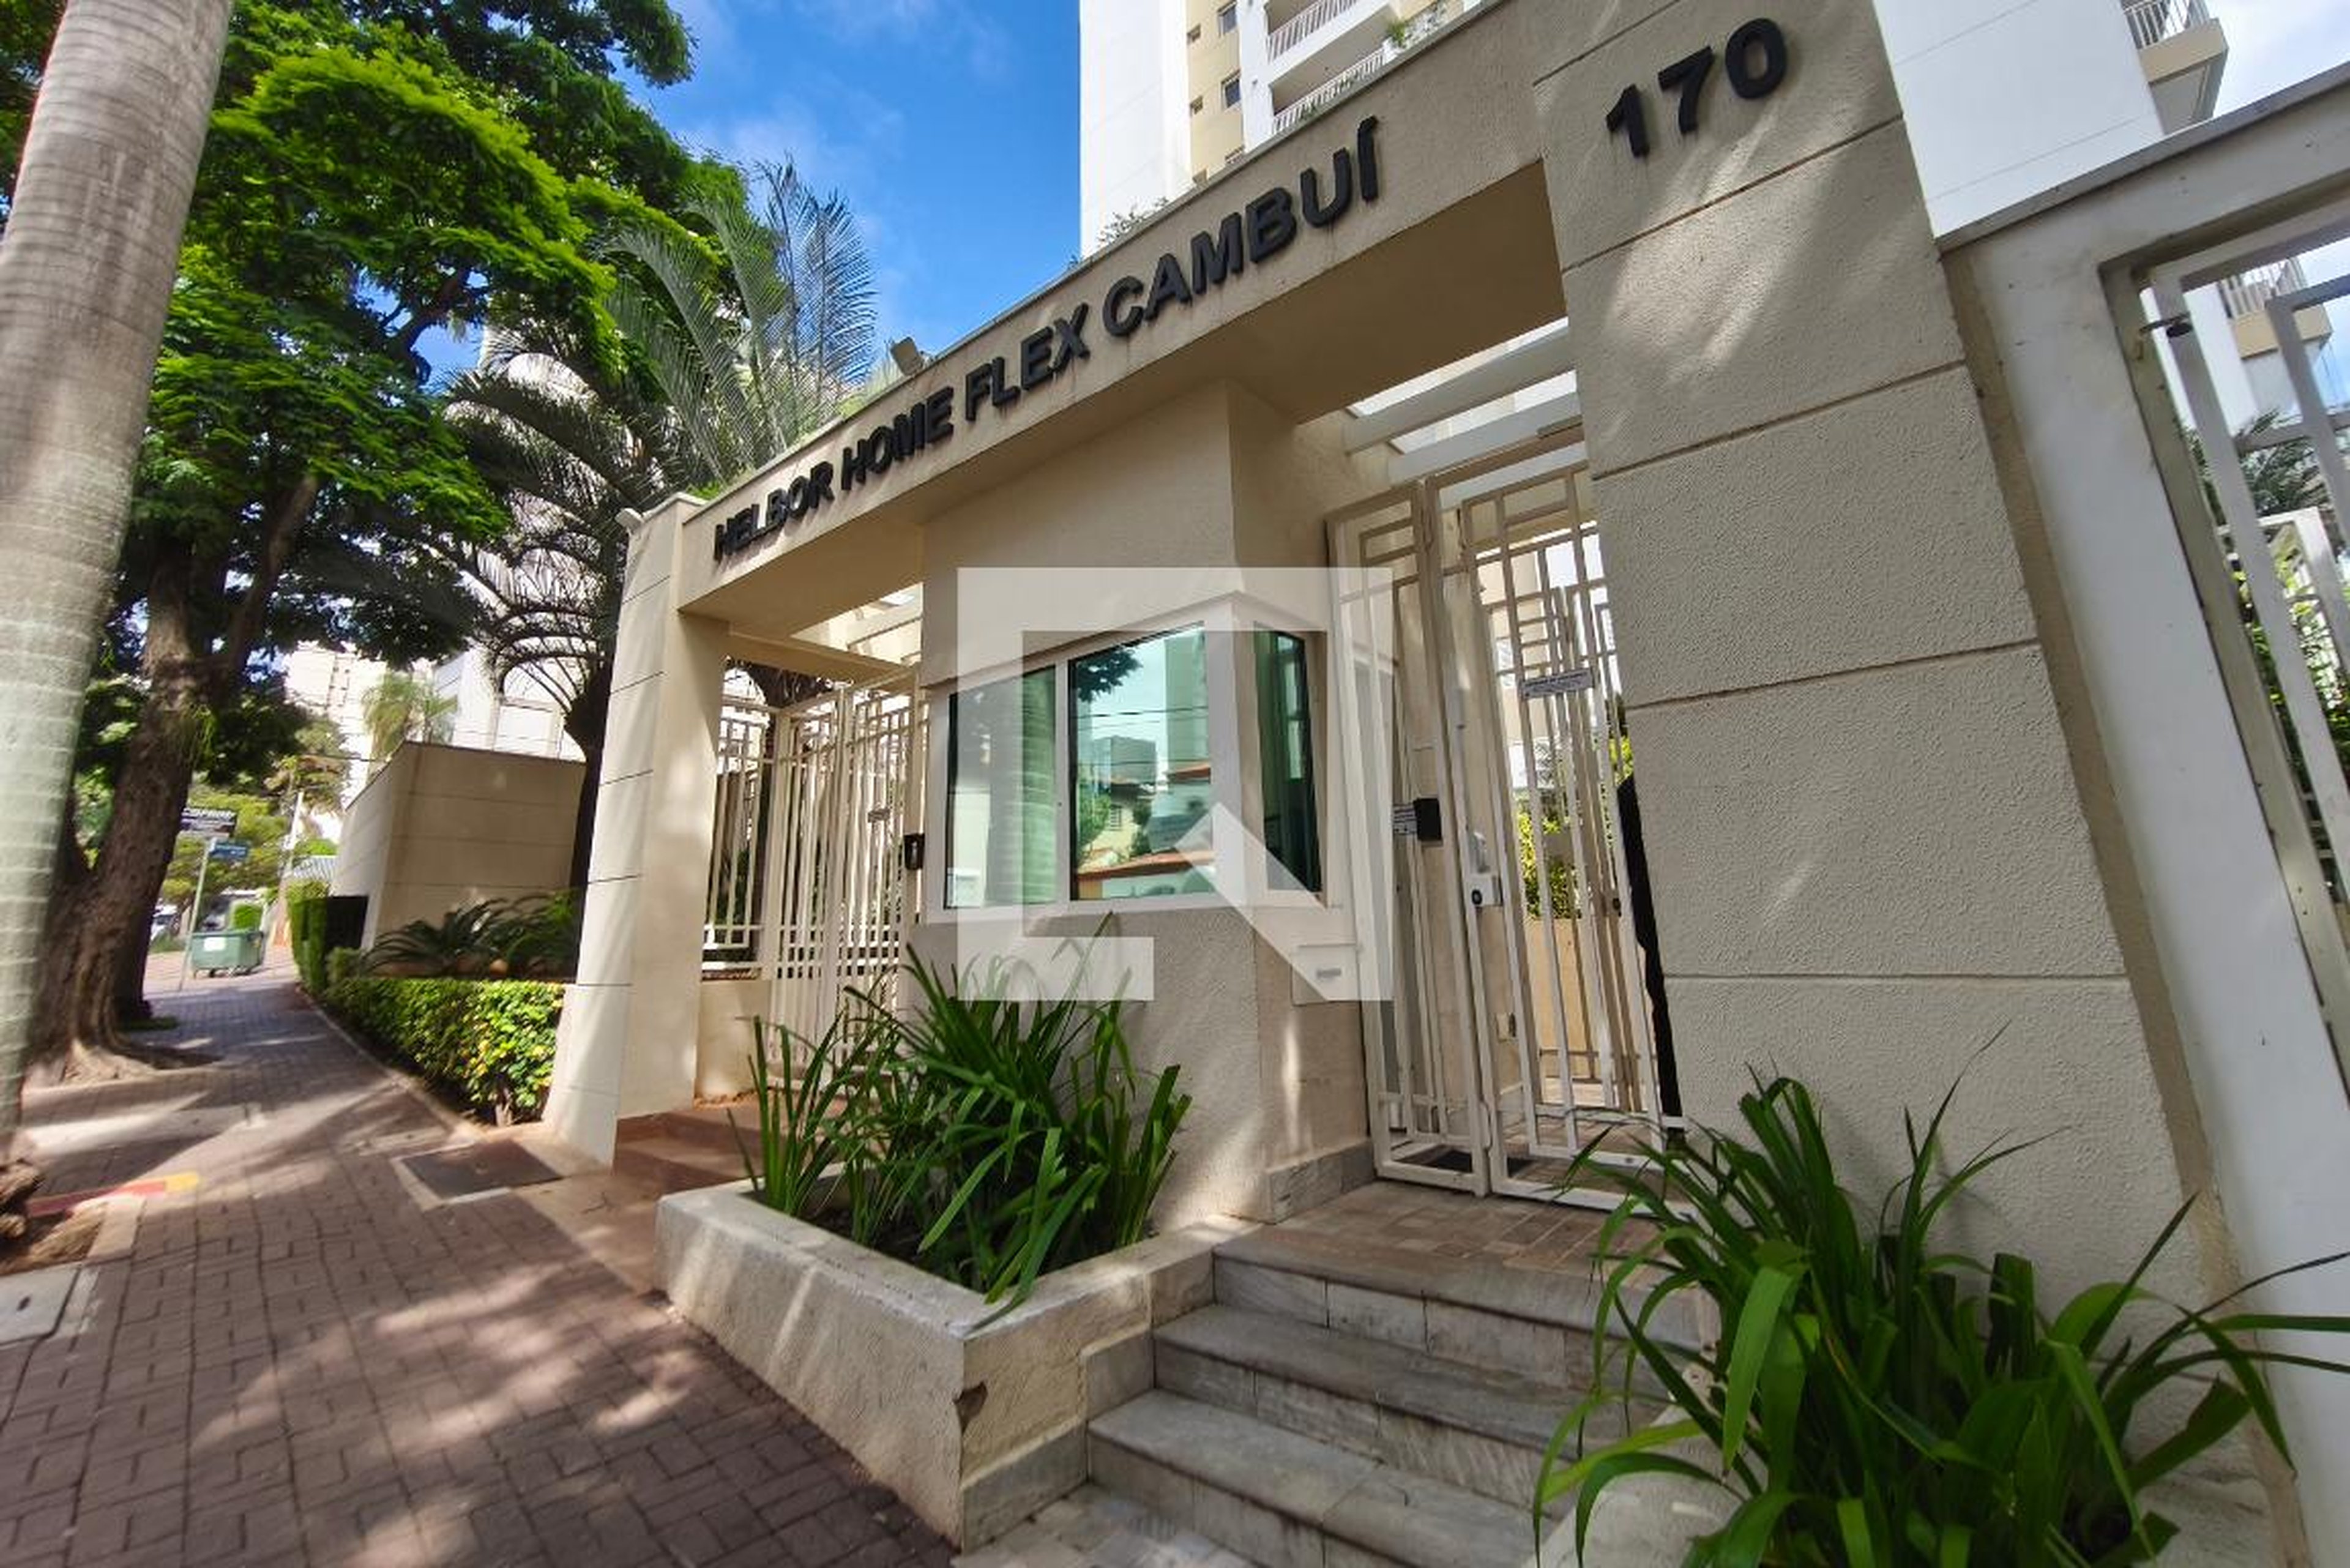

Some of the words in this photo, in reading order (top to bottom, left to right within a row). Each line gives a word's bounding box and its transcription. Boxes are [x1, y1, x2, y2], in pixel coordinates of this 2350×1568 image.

[1605, 18, 1787, 158] 170
[714, 461, 834, 561] HELBOR
[840, 386, 954, 491] HOME
[965, 302, 1091, 420] FLEX
[1103, 115, 1378, 337] CAMBUÍ
